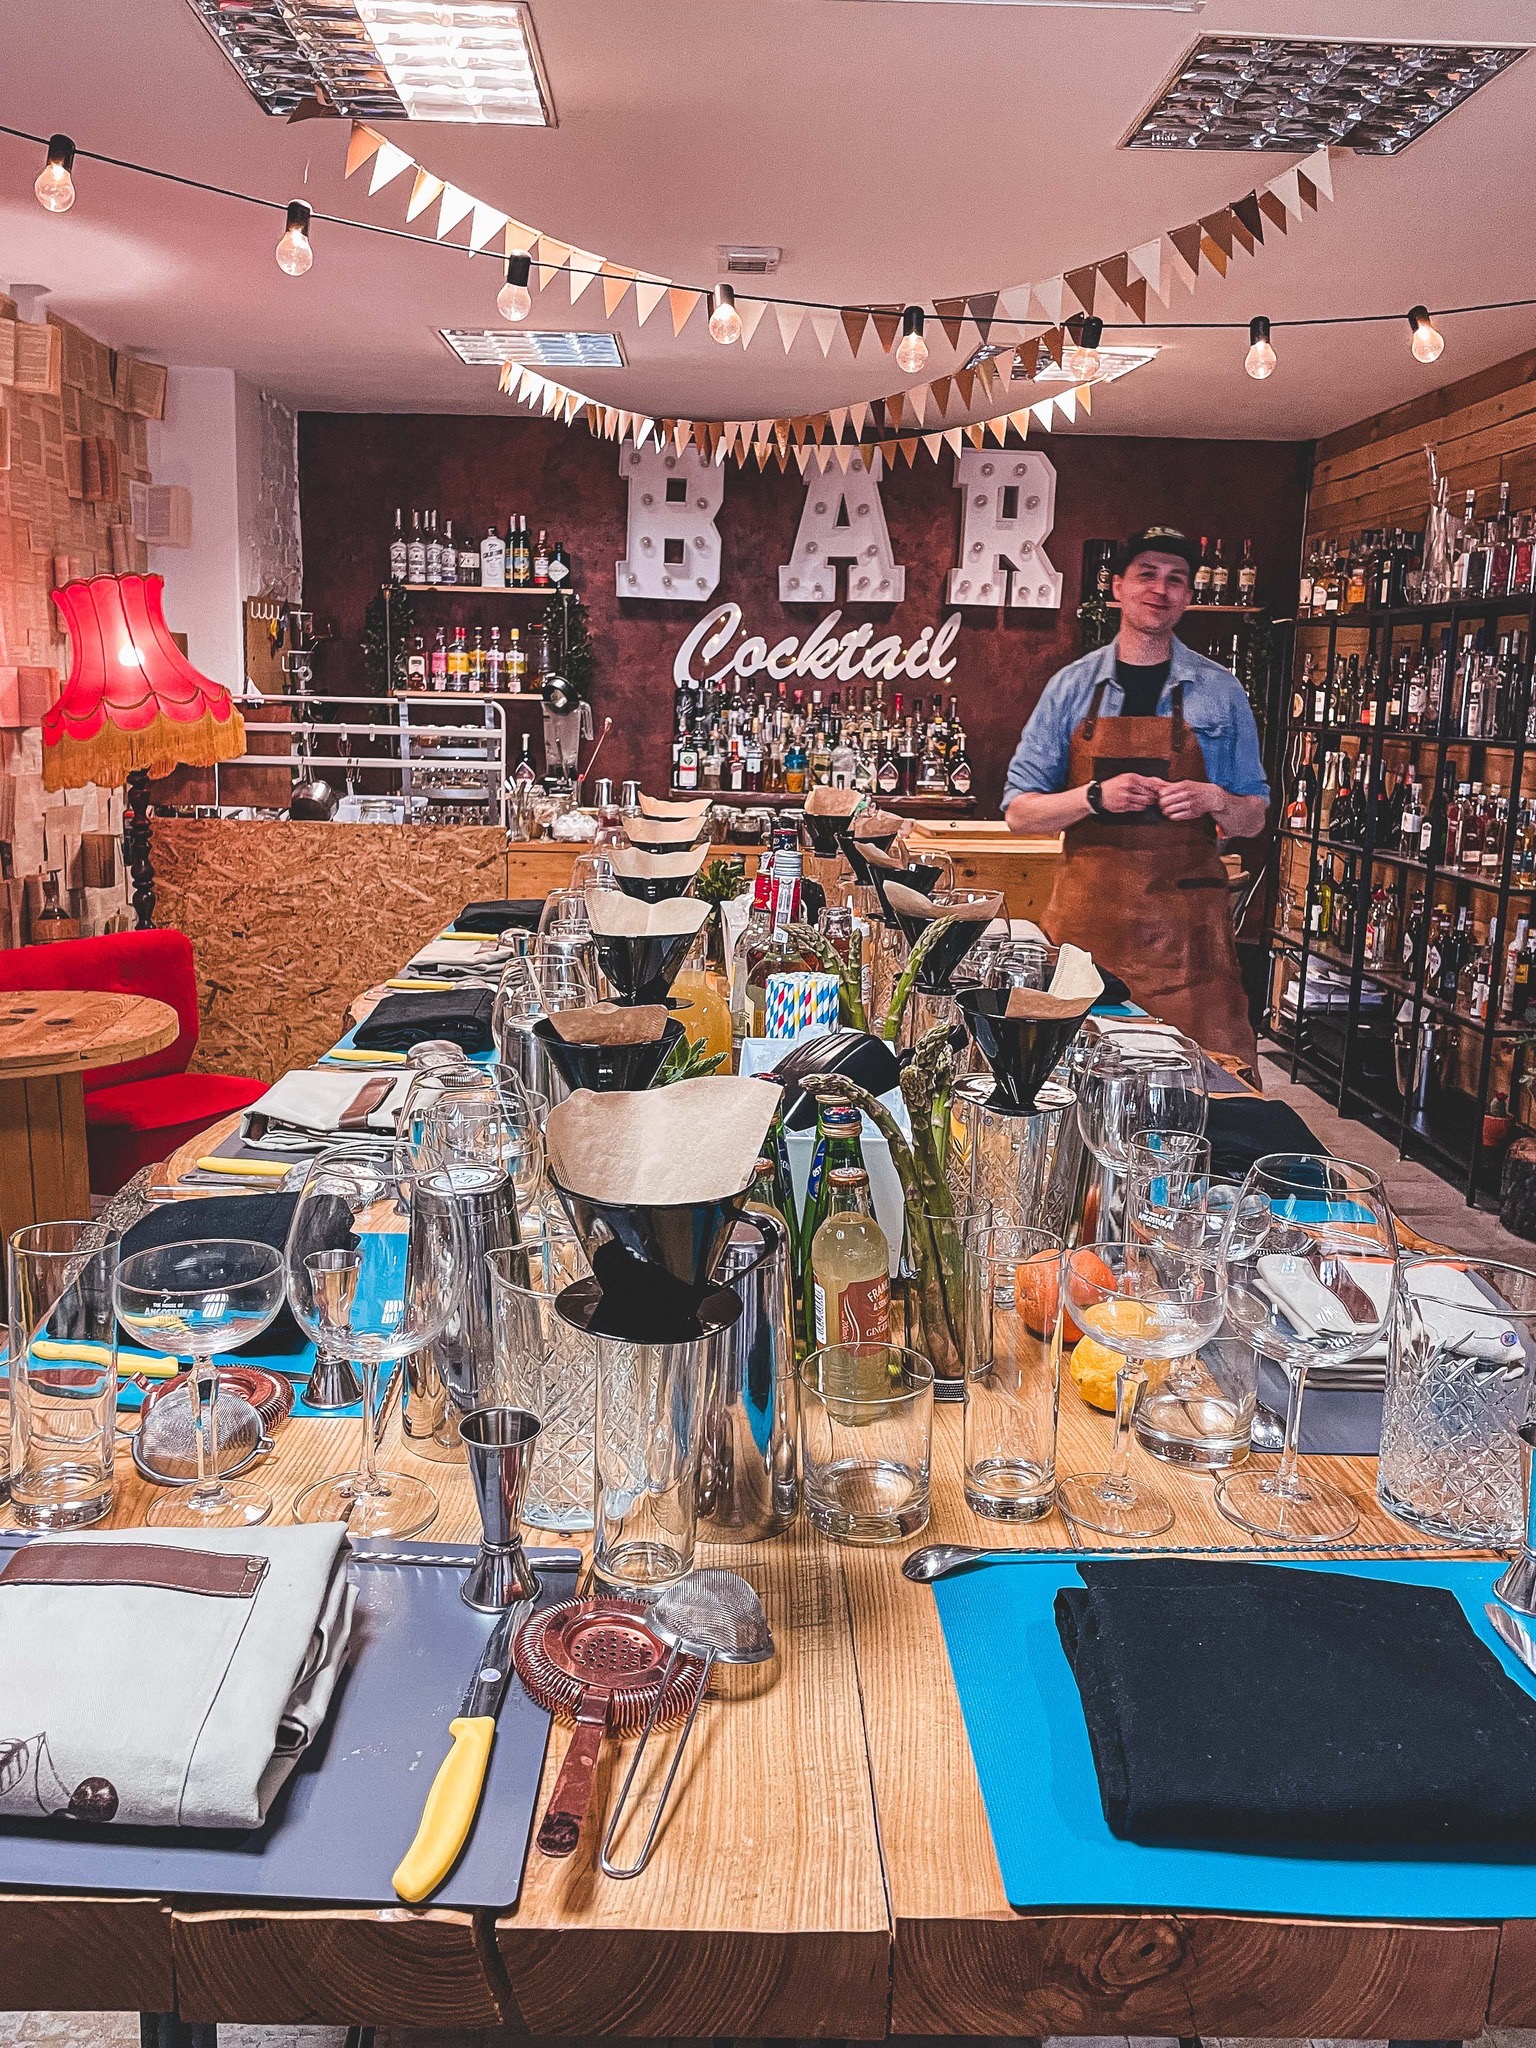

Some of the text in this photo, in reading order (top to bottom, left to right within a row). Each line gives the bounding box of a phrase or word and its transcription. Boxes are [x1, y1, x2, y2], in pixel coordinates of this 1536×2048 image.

[615, 439, 1063, 609] BAR
[673, 602, 963, 689] Cocktail
[144, 1307, 194, 1318] ANGOSTURA
